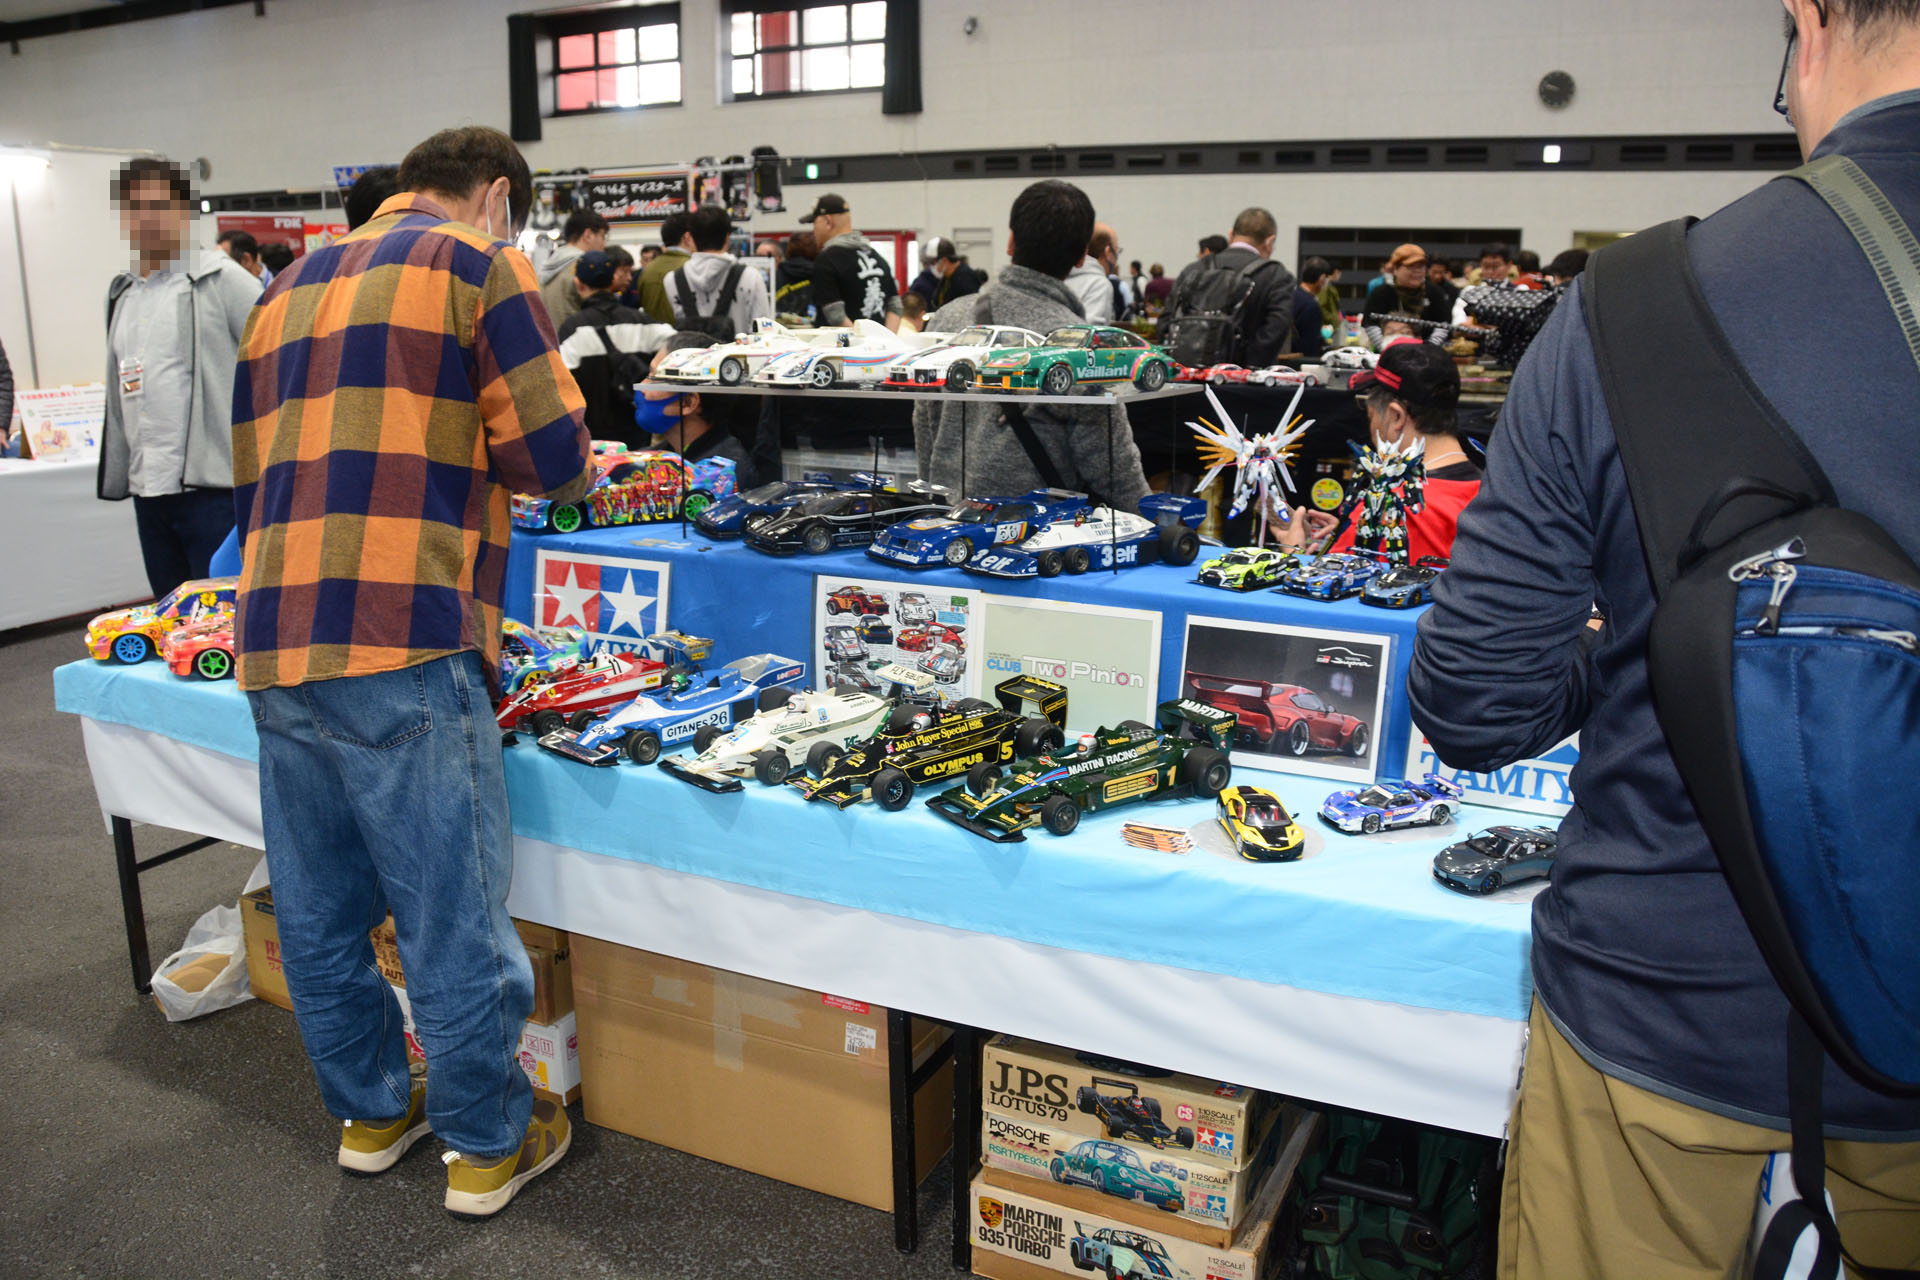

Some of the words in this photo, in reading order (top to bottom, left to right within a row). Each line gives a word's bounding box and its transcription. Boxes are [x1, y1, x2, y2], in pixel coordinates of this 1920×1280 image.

[1086, 350, 1096, 367] 5
[1077, 364, 1129, 379] Vaillant
[971, 549, 990, 562] 3
[981, 555, 1015, 571] elf
[1101, 545, 1114, 567] 3
[1116, 545, 1138, 564] elf
[986, 658, 1022, 673] CLUB
[1069, 660, 1145, 689] Pinion
[1177, 699, 1233, 720] MARTIN
[666, 719, 708, 738] GITANES
[710, 711, 728, 727] 26
[1211, 719, 1235, 733] TISSOT
[895, 739, 917, 752] John
[916, 732, 941, 745] Player
[940, 721, 969, 739] Special
[1000, 740, 1014, 760] 5
[923, 752, 984, 776] OLYMPUS
[1067, 758, 1105, 776] MARTINI
[1106, 748, 1139, 766] RACING
[1106, 774, 1156, 797] ESSEX
[1166, 765, 1177, 787] 1
[1420, 751, 1575, 806] TAMIY
[384, 968, 405, 981] AUT
[989, 1061, 1076, 1111] J.P.S.
[989, 1091, 1048, 1118] LOTUS
[1048, 1106, 1069, 1122] 79
[1177, 1105, 1194, 1121] CS
[1211, 1110, 1236, 1121] SCALE
[989, 1117, 1051, 1146] PORSCHE
[1197, 1143, 1233, 1158] TAMIYA
[1203, 1174, 1228, 1184] SCALE
[1003, 1203, 1063, 1233] MARTINI
[1189, 1206, 1226, 1221] TAMIYA
[979, 1226, 1005, 1247] 935
[1005, 1233, 1051, 1260] TURBO
[1003, 1218, 1066, 1249] PORSCHE
